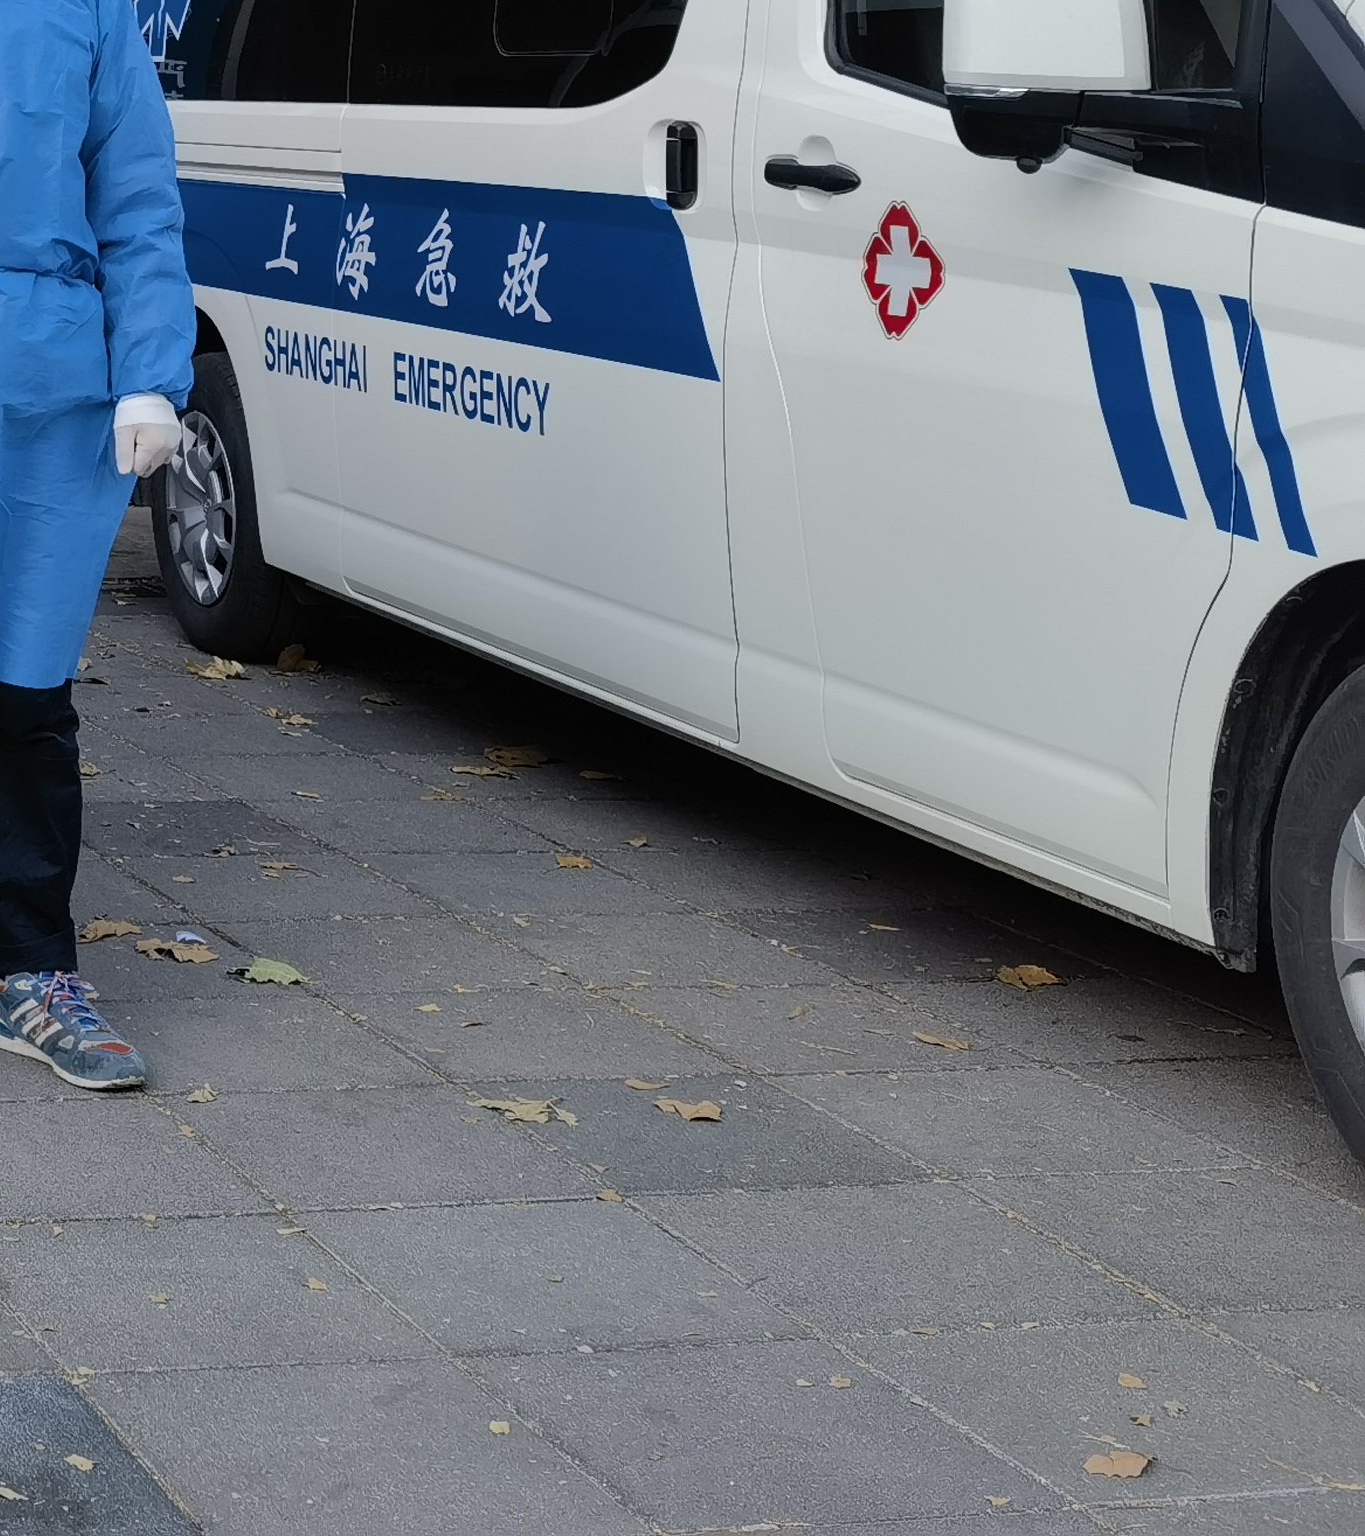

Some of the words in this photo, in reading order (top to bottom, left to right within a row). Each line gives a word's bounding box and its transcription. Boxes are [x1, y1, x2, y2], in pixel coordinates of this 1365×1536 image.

[265, 203, 552, 323] 上海急救
[264, 325, 368, 394] SHANGHAI
[393, 351, 550, 436] EMERGENCY
